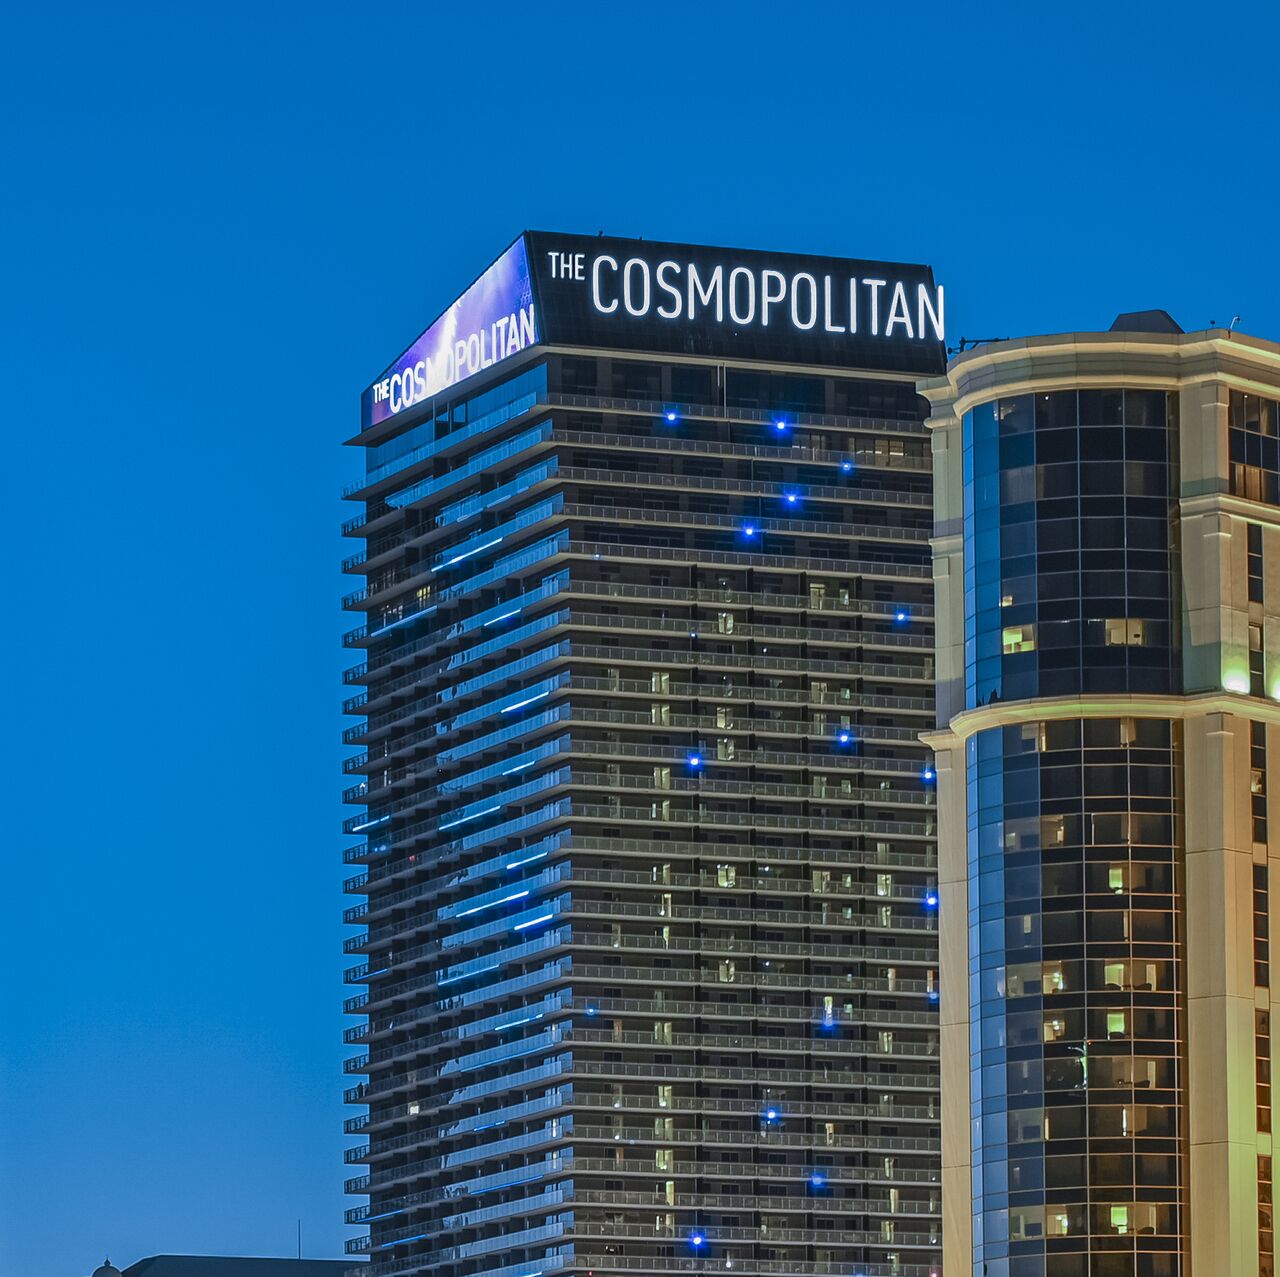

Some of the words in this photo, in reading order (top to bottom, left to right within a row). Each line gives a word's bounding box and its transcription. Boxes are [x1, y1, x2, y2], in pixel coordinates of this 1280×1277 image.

[548, 251, 586, 281] THE
[592, 254, 945, 341] COSMOPOLITAN
[373, 378, 390, 404] THE
